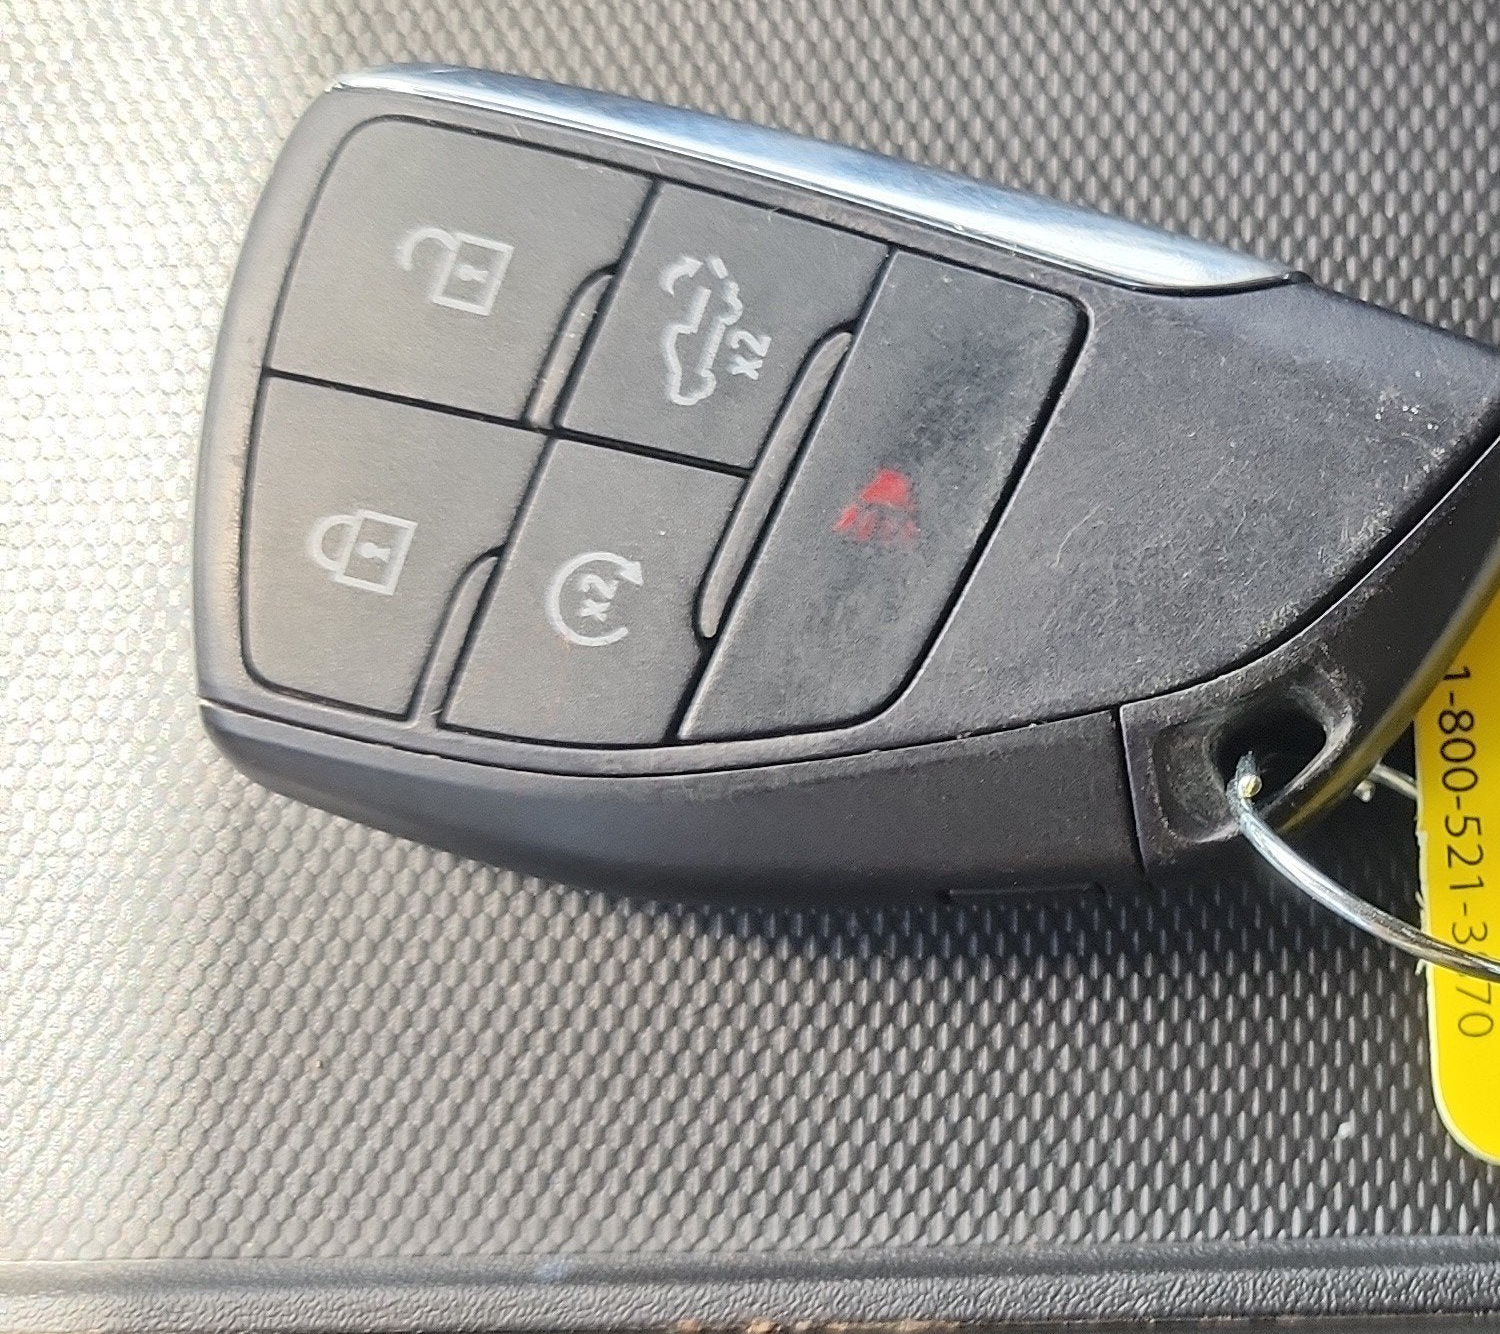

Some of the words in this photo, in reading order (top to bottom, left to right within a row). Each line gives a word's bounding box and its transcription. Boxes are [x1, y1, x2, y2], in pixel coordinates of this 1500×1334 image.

[727, 329, 771, 380] x2
[579, 573, 618, 622] x2
[1437, 664, 1495, 1038] 1-800-521-370
